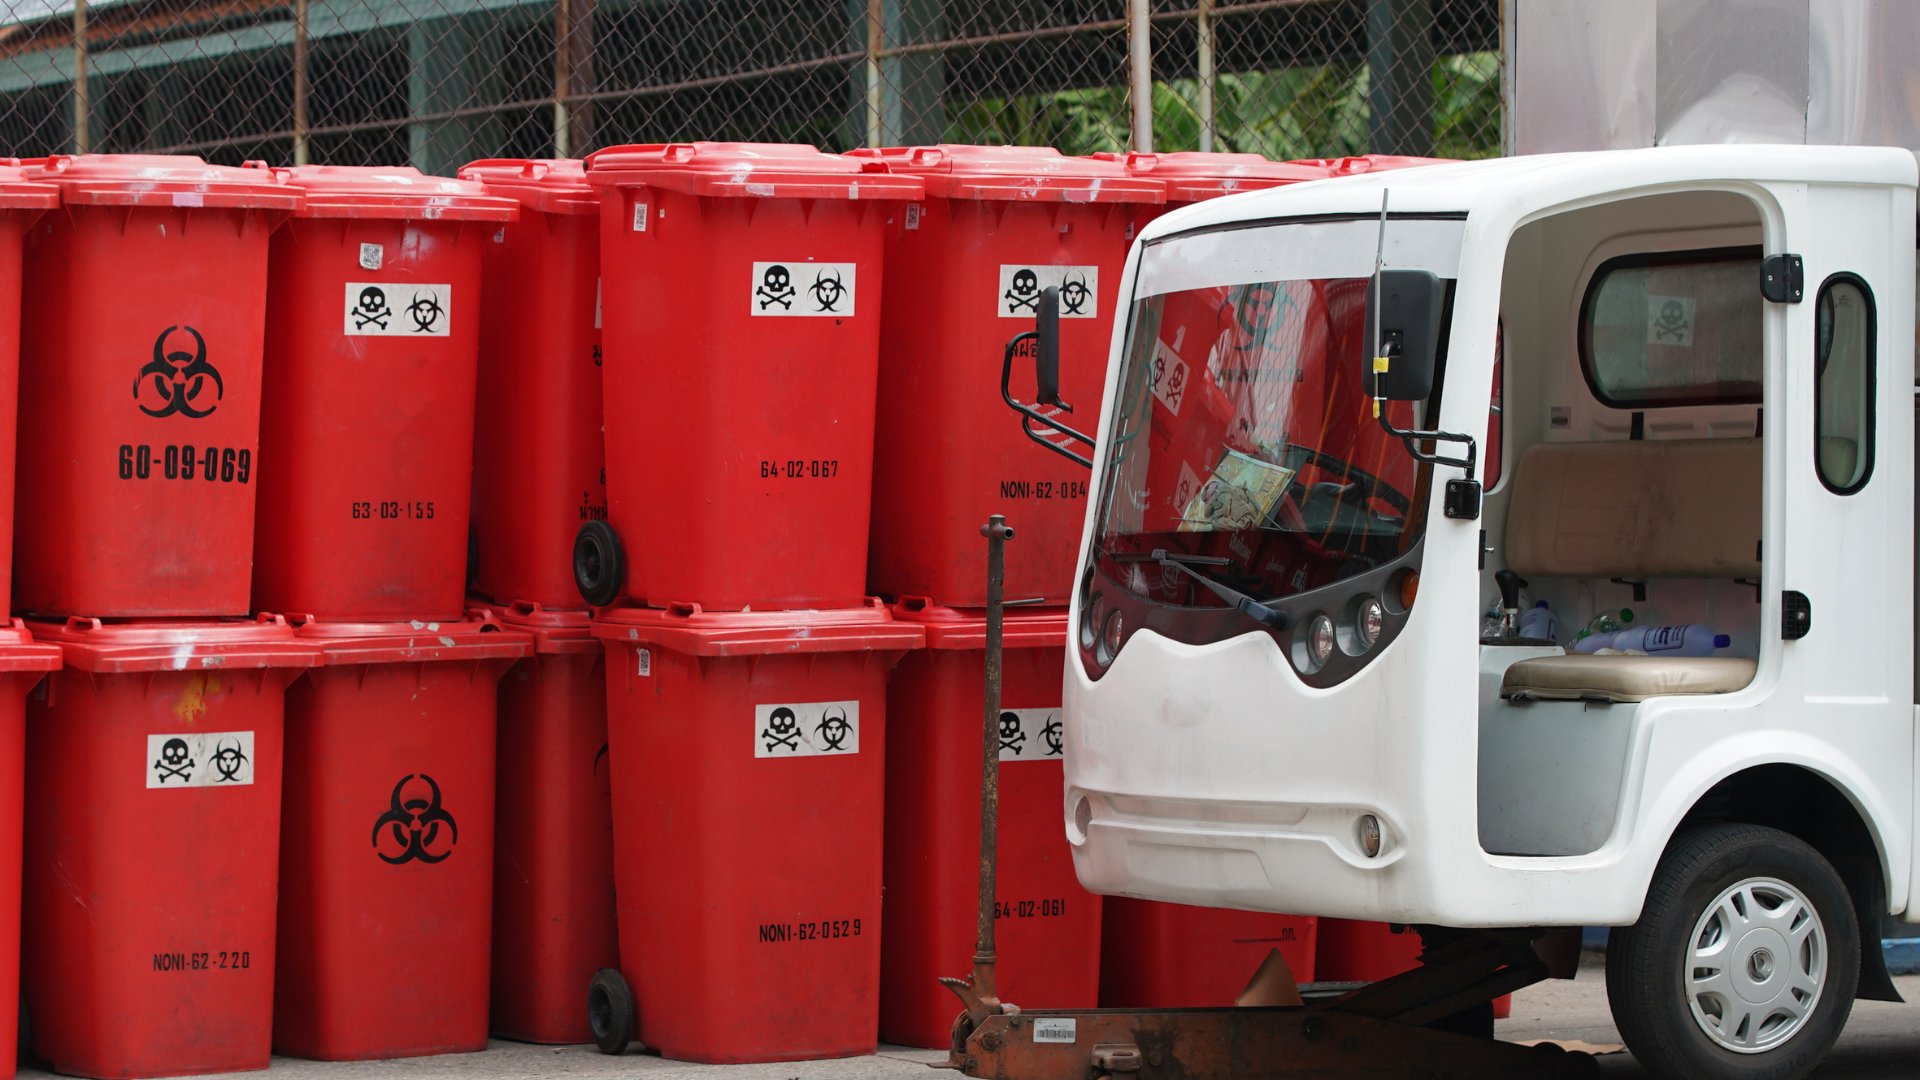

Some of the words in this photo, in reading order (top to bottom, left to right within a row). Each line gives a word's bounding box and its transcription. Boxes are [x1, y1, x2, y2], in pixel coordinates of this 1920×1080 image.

[119, 444, 251, 484] 60-09-069
[761, 460, 838, 478] 64-02-067
[352, 502, 434, 518] 63-03-155
[994, 899, 1065, 919] 64-02-061
